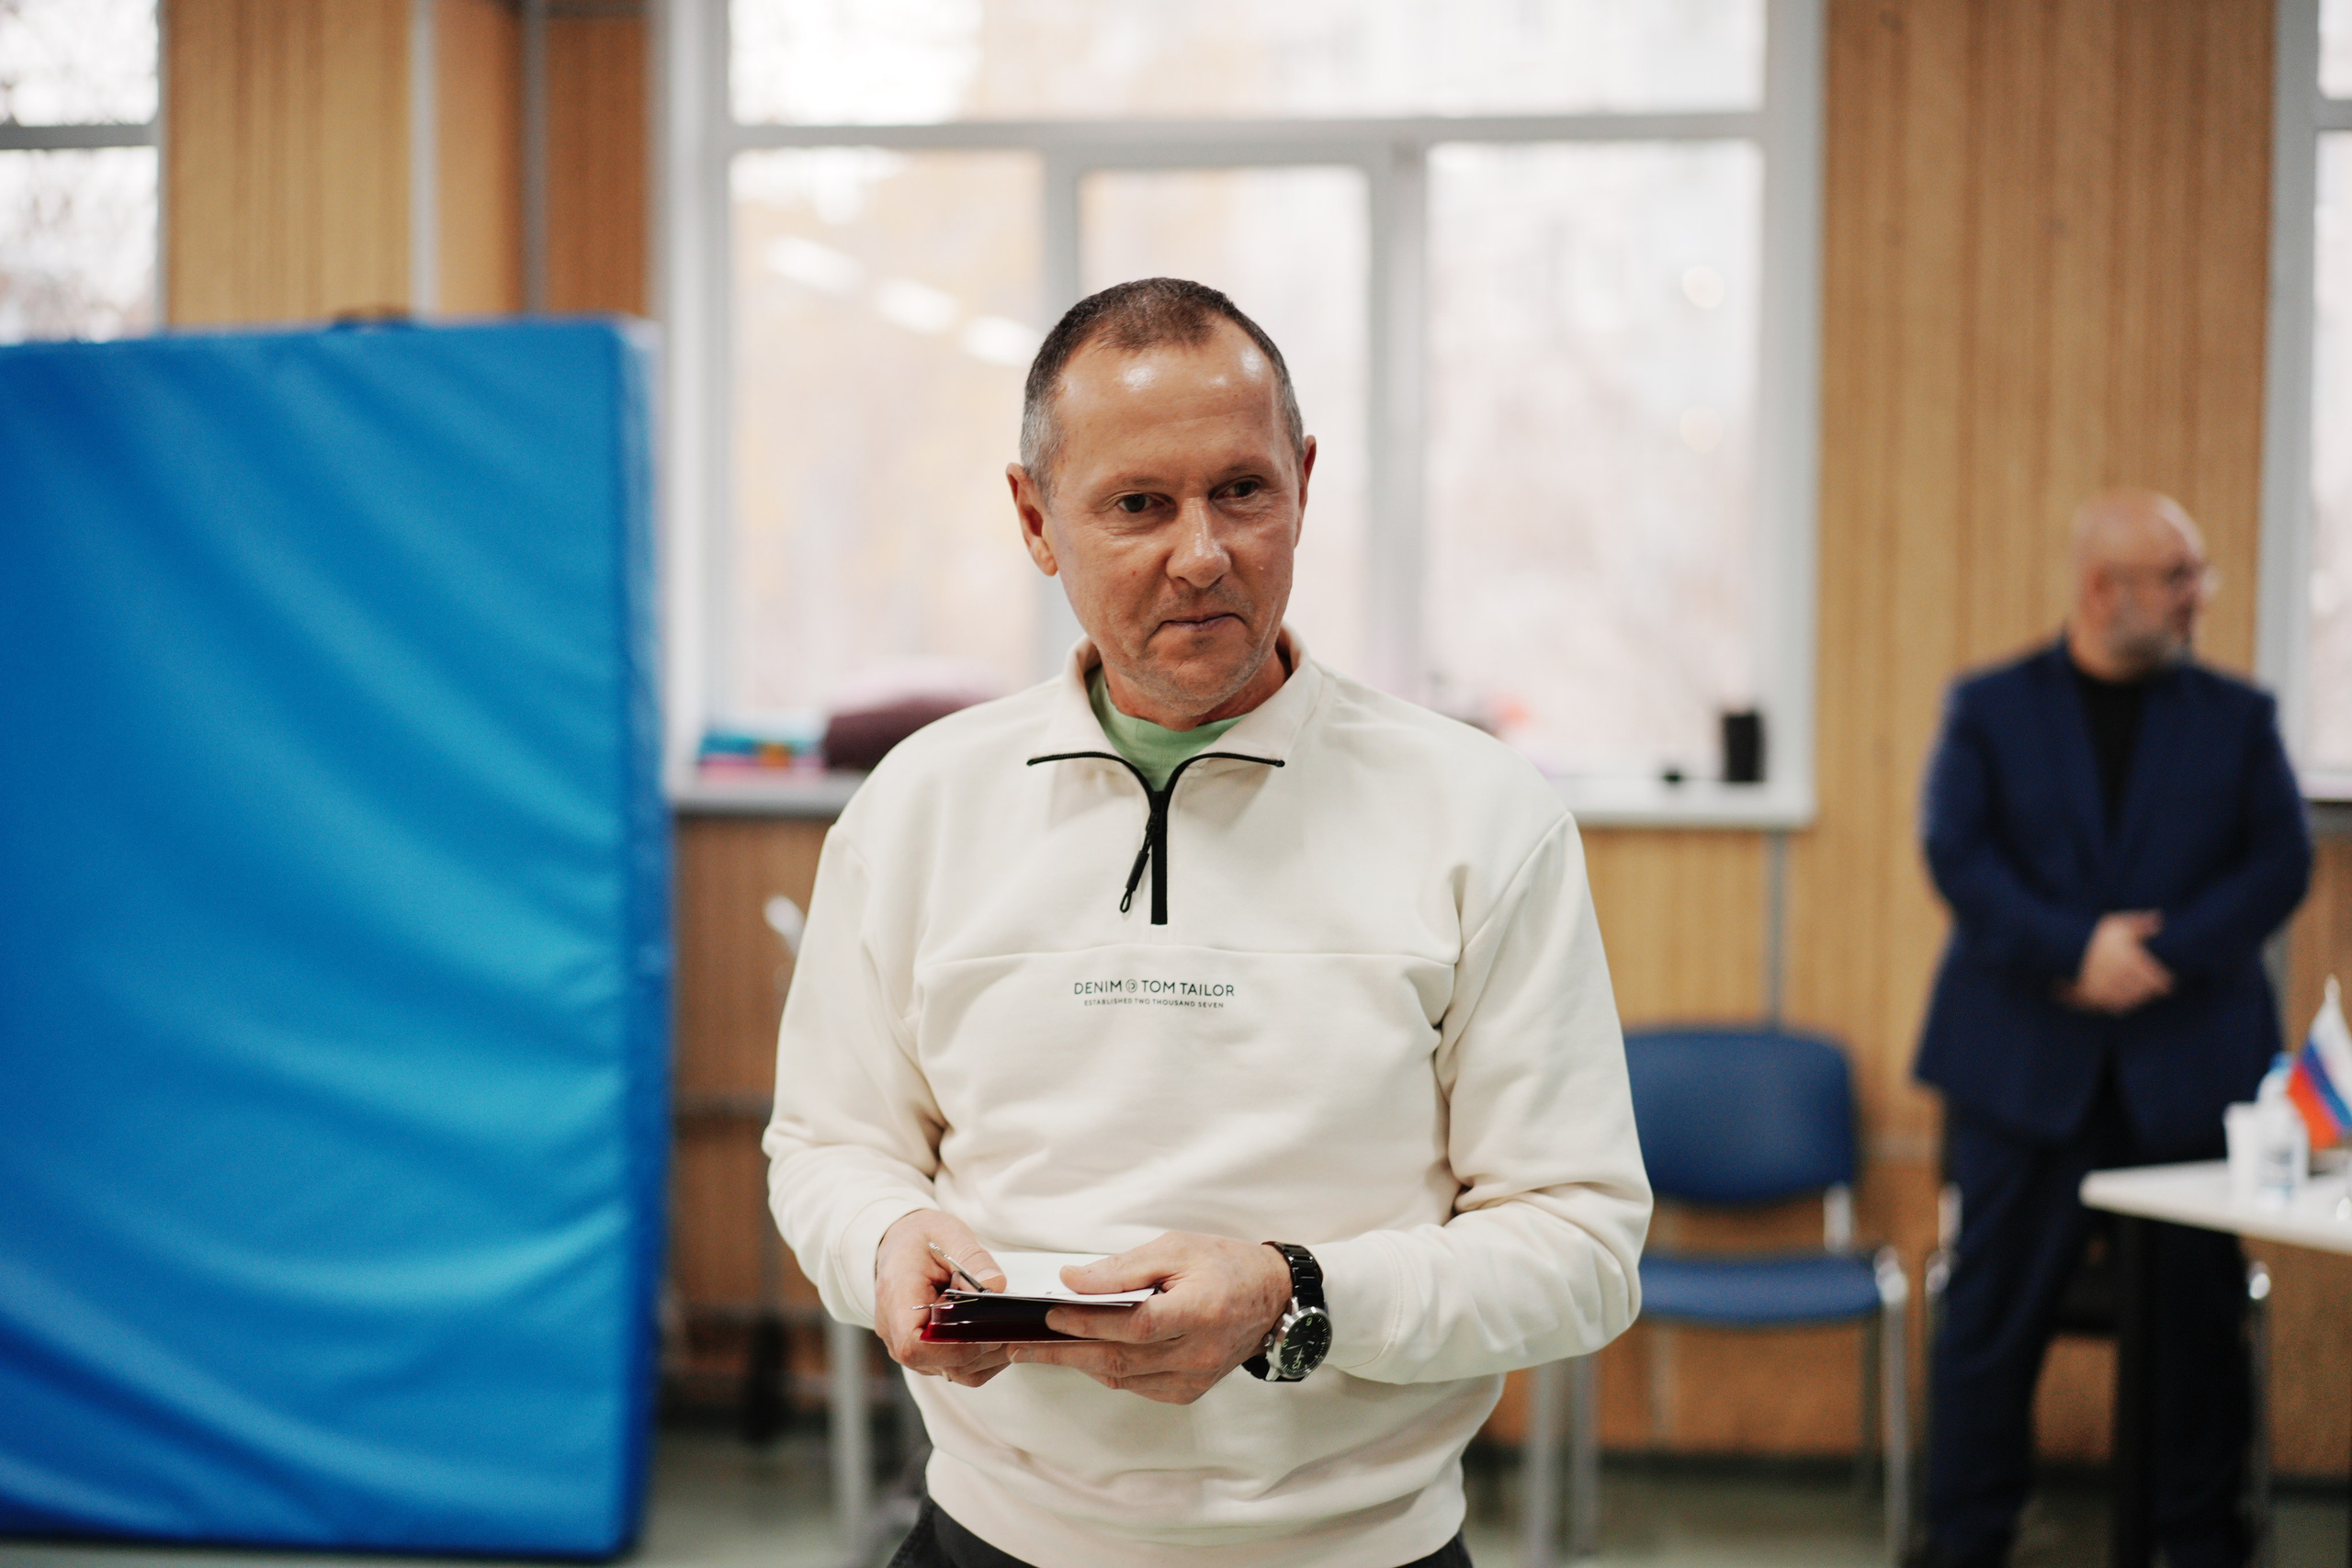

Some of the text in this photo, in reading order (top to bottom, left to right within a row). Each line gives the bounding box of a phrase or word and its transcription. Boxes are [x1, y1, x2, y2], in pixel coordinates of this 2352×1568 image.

[1074, 980, 1122, 995] DENIM
[1141, 980, 1175, 993] TOM
[1180, 982, 1235, 997] TAILOR
